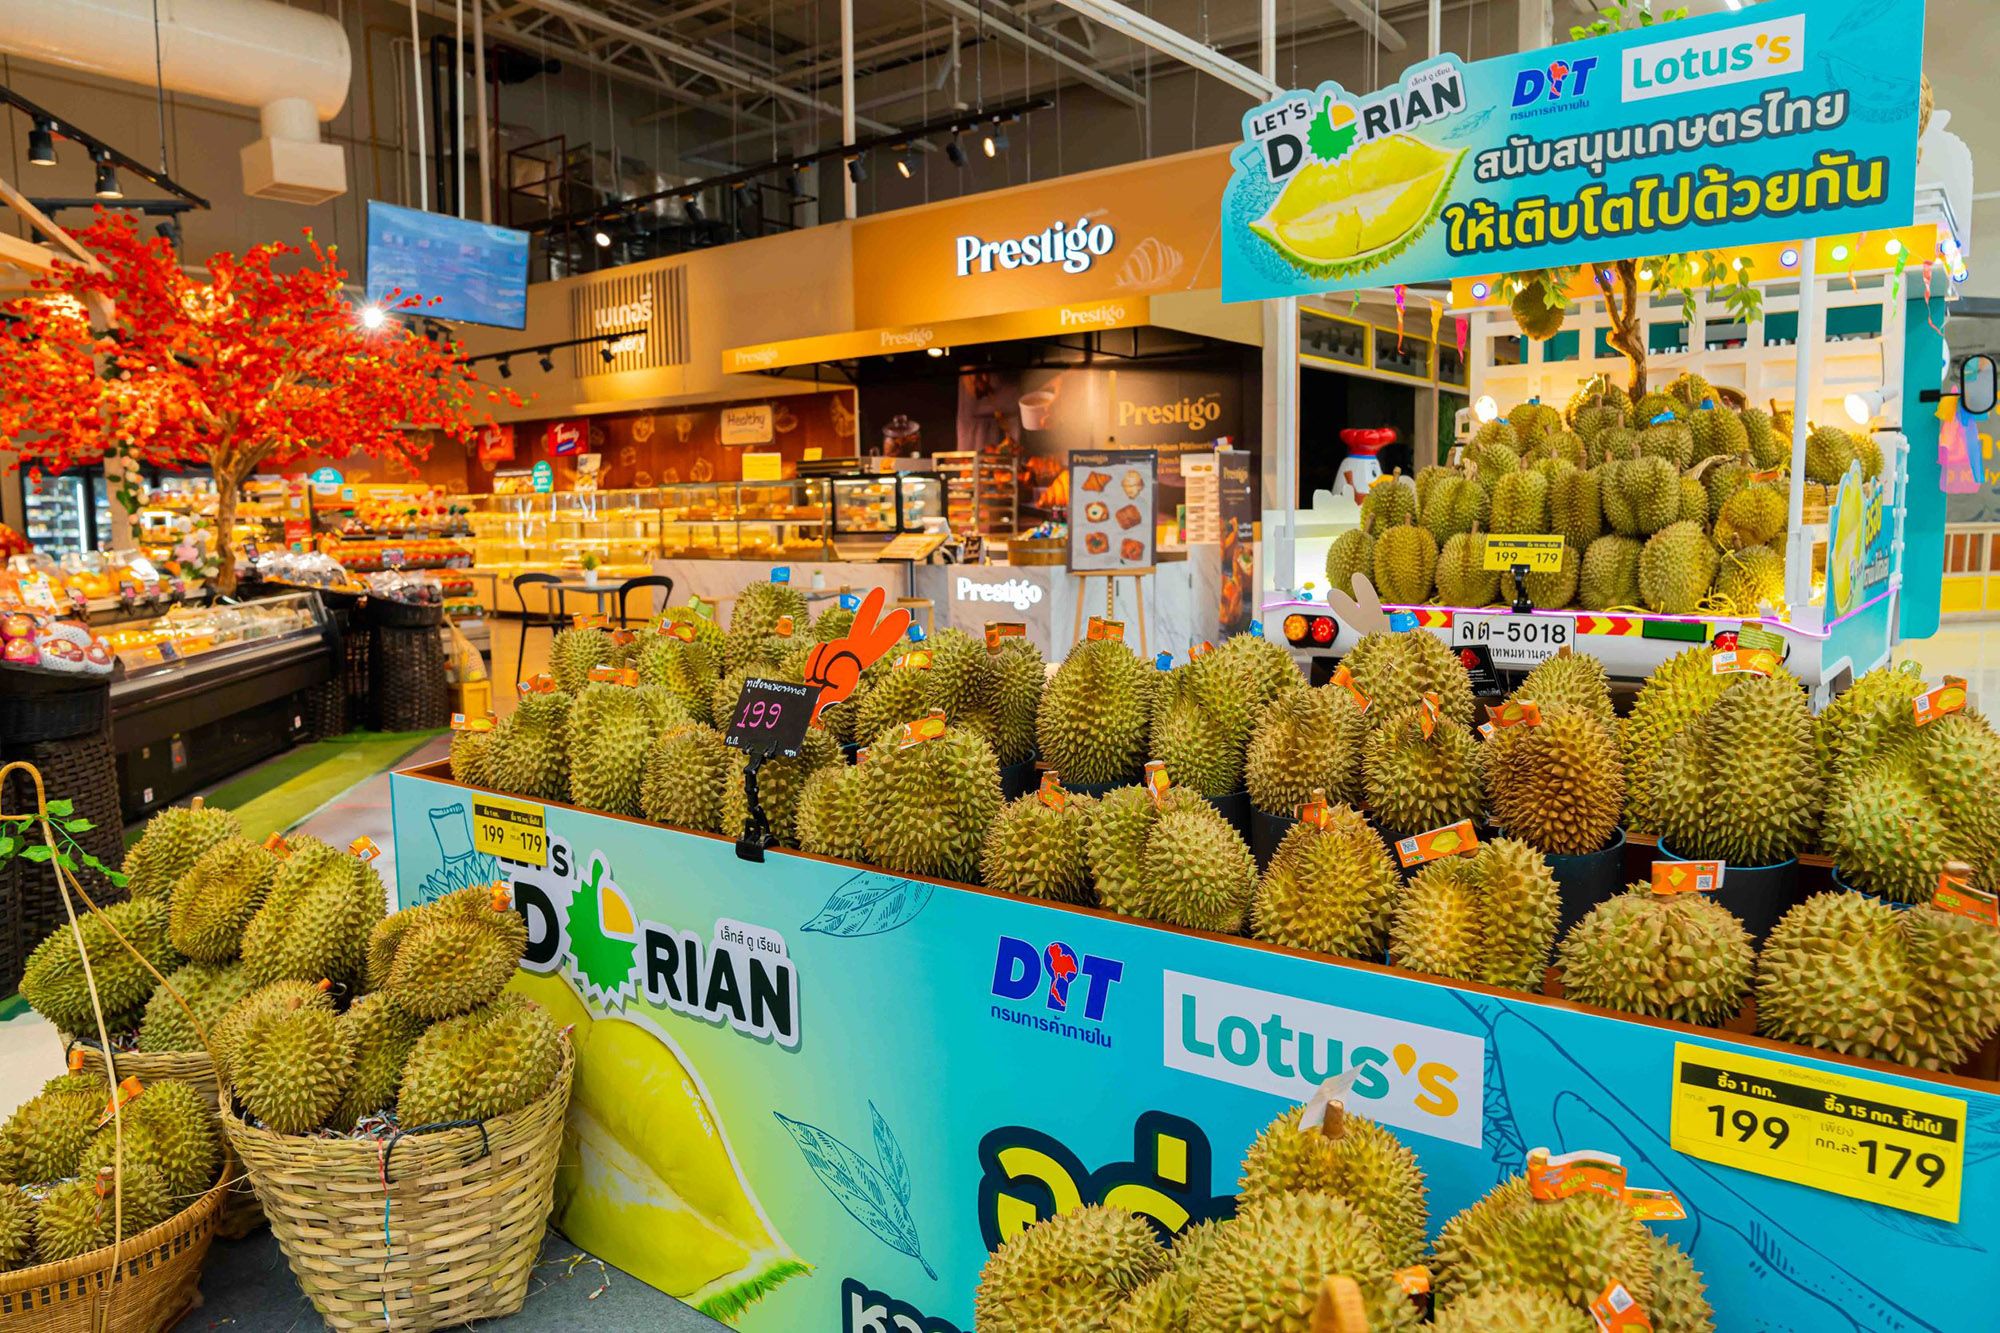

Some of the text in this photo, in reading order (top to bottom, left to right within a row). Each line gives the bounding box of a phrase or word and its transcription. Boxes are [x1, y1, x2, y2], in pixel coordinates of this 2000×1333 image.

[1632, 33, 1793, 90] Lotus's
[1253, 102, 1307, 136] LET'S
[1477, 90, 1846, 177] สนับสนุนเกษตรไทย
[1446, 153, 1884, 252] ให้เติบโตไปด้วยกัน
[956, 217, 1115, 277] Prestigo
[1060, 304, 1126, 327] Prestigo
[879, 327, 934, 348] Prestigo
[1117, 397, 1221, 431] Prestigo
[1495, 551, 1518, 562] 199
[1535, 552, 1558, 564] 179
[957, 577, 1043, 610] Prestigo
[736, 700, 783, 729] 199
[482, 824, 504, 844] 199
[520, 831, 542, 853] 179
[746, 936, 754, 952] ดู
[756, 936, 781, 954] เรียน
[990, 1004, 1113, 1049] กรมการค้าภายใน
[1181, 992, 1460, 1118] Lotus's
[1717, 1071, 1777, 1099] ซื้อ 1 กก.
[1707, 1104, 1790, 1150] 199
[1824, 1093, 1943, 1136] ซื้อ 15 กก. ขึ้นไป
[1815, 1136, 1858, 1156] กก.ละ
[1858, 1139, 1946, 1189] 179
